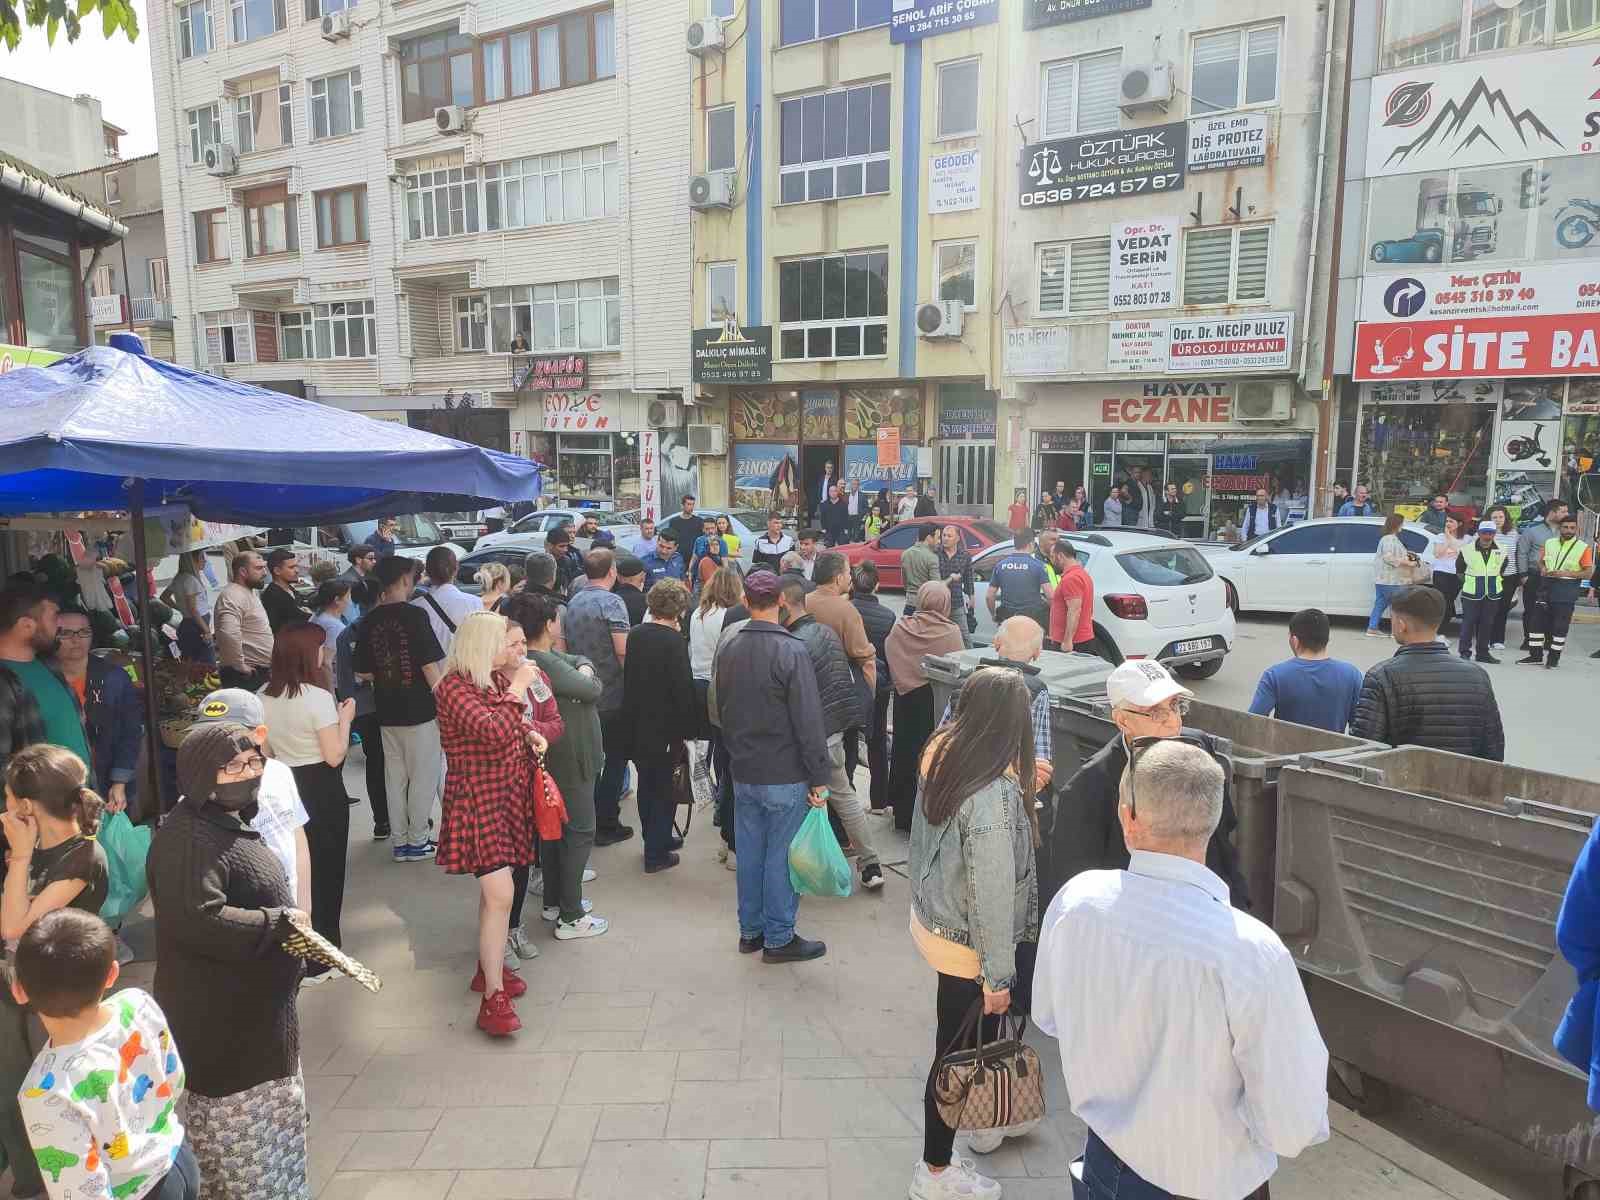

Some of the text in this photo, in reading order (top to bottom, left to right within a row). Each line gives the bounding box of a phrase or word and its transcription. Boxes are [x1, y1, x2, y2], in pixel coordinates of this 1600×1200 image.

[1079, 132, 1166, 157] ÖZTÜRK
[1218, 128, 1263, 146] PROTEZ
[935, 151, 976, 169] GEODEK
[1070, 147, 1175, 171] HUKUK BÜROSU
[1021, 173, 1180, 206] 0536 724 57 67
[1117, 234, 1172, 250] VEDAT
[1114, 294, 1131, 306] 0552
[1133, 293, 1147, 305] 803
[1518, 288, 1535, 300] 40
[1173, 321, 1285, 341] Opr. Dr. NECİP ULUZ
[729, 345, 767, 357] MİMARLIK
[1231, 341, 1279, 353] UZMANI
[1422, 325, 1530, 371] SİTE
[1143, 382, 1227, 397] HAYAT
[1102, 396, 1232, 424] ECZANE
[544, 413, 609, 429] TÜTÜN
[643, 433, 656, 521] TÜTÜN
